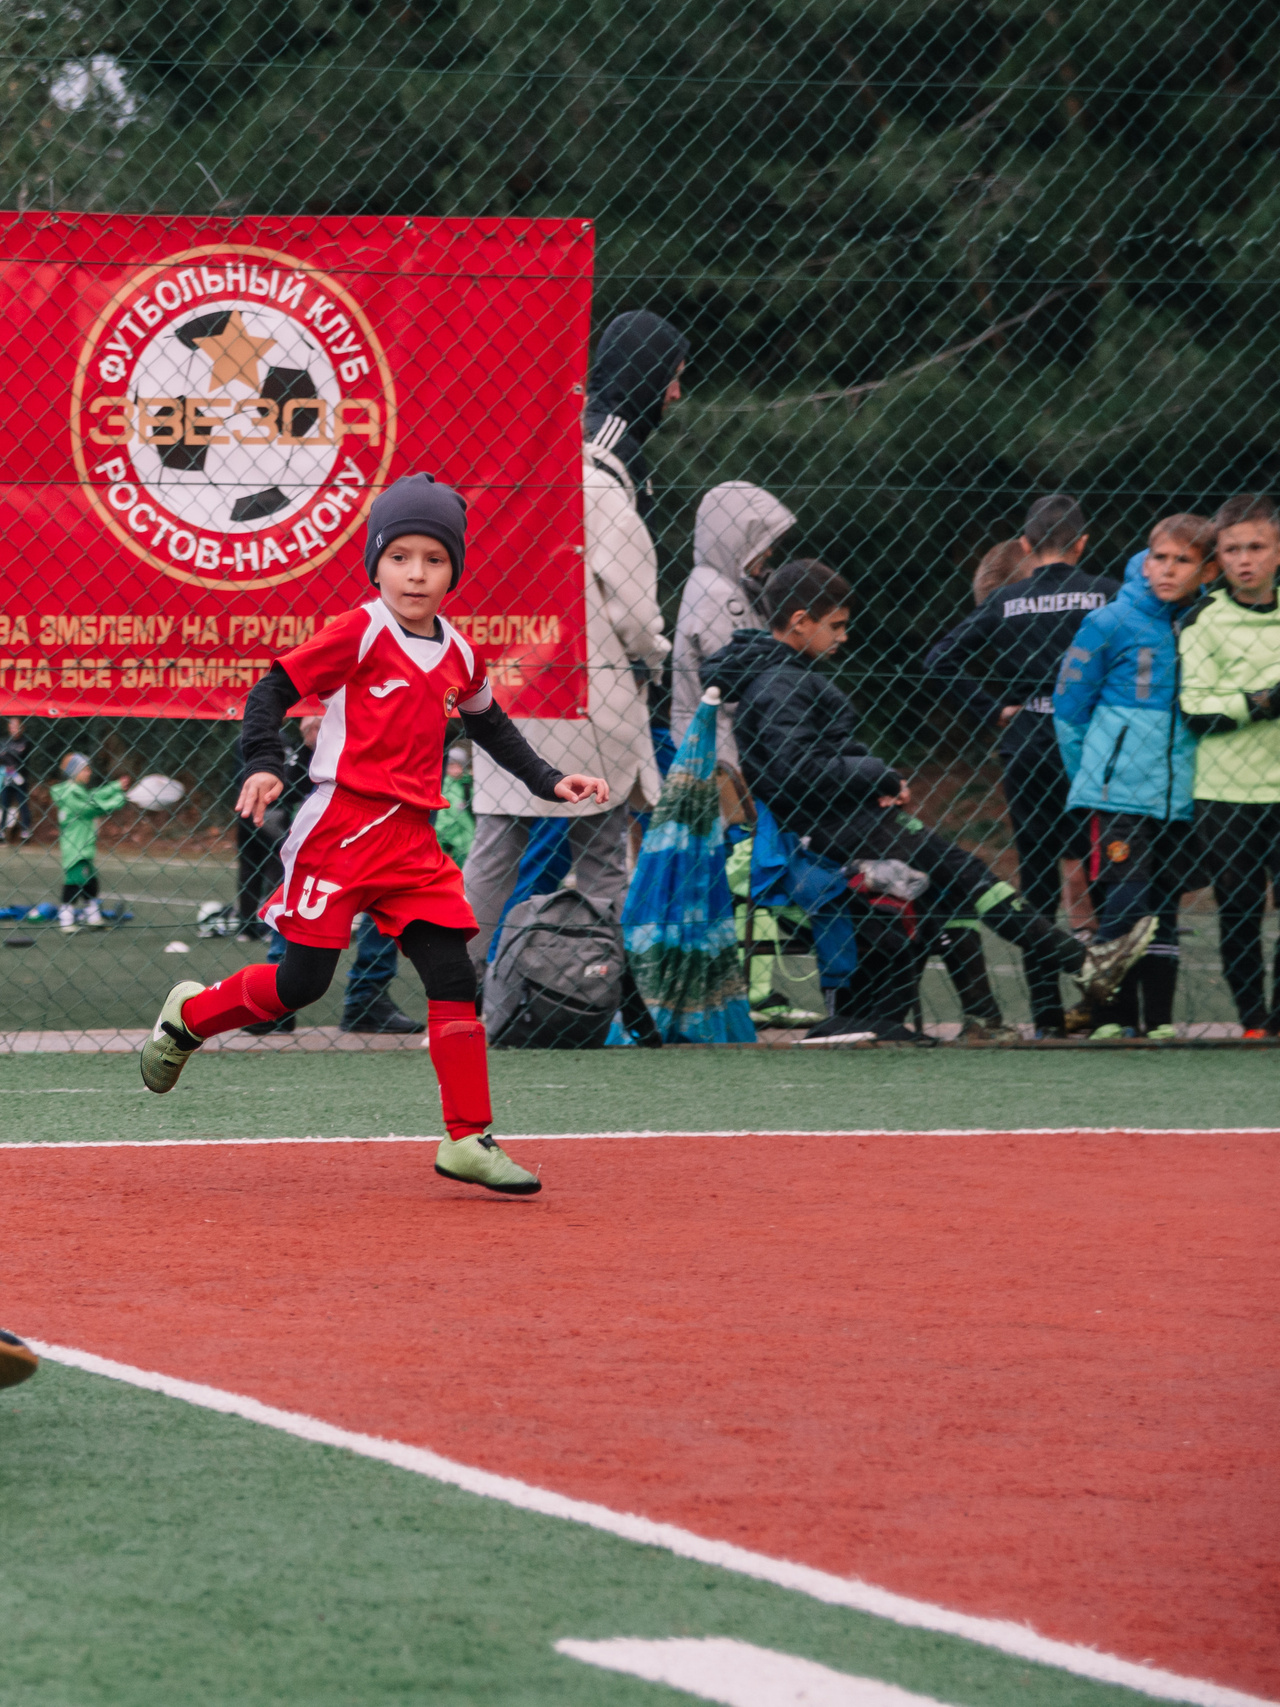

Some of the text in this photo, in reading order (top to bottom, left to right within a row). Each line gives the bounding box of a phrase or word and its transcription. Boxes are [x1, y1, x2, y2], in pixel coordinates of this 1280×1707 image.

[98, 262, 370, 383] ФУТБОЛЬНЫЙ КЛУБ
[88, 397, 381, 447] ЗВЕЗДА
[95, 456, 366, 573] РОСТОВ-НА-ДОНУ
[39, 615, 175, 645] ЭМБЛЕМУ
[181, 615, 221, 645] НА
[228, 615, 316, 648] ГРУДИ
[450, 614, 561, 645] ТБОЛКИ
[61, 658, 112, 688] ВСЕ
[121, 657, 271, 688] ЗАПОМНЯТ
